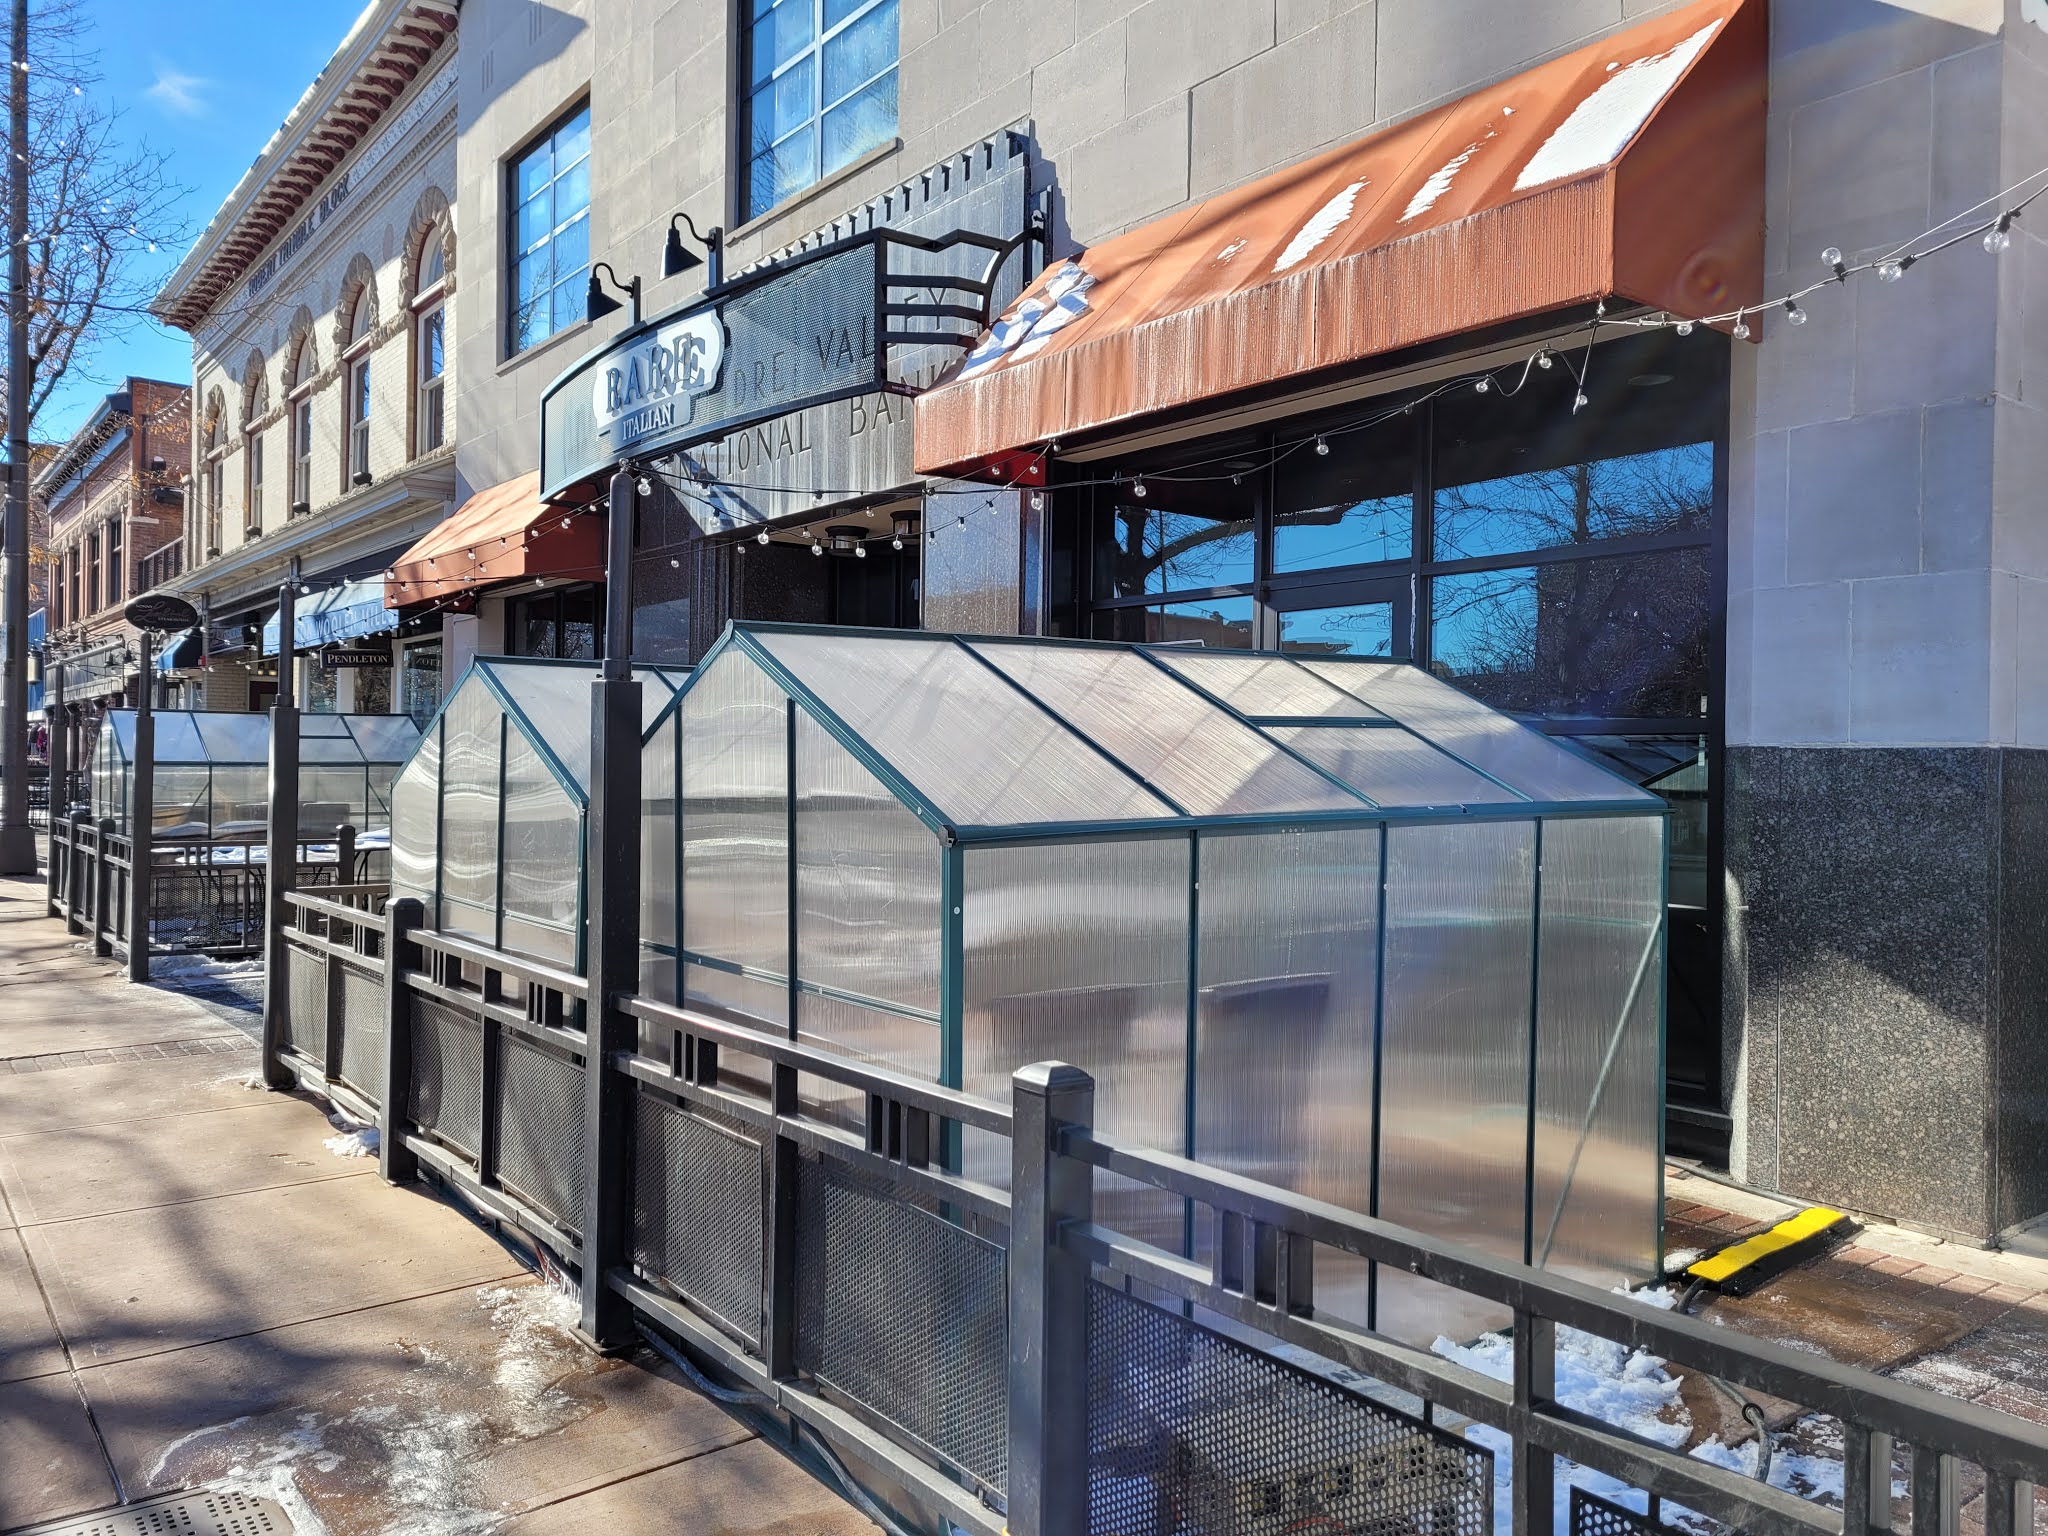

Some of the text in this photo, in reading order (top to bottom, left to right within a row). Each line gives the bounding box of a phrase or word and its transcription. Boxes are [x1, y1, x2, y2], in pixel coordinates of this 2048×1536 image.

[319, 173, 350, 223] BLOCK
[606, 332, 705, 417] RARE
[622, 402, 675, 440] ITALIAN
[679, 413, 812, 491] NATIONAL
[315, 609, 358, 638] WOOLEN
[327, 653, 388, 664] PENDLETON
